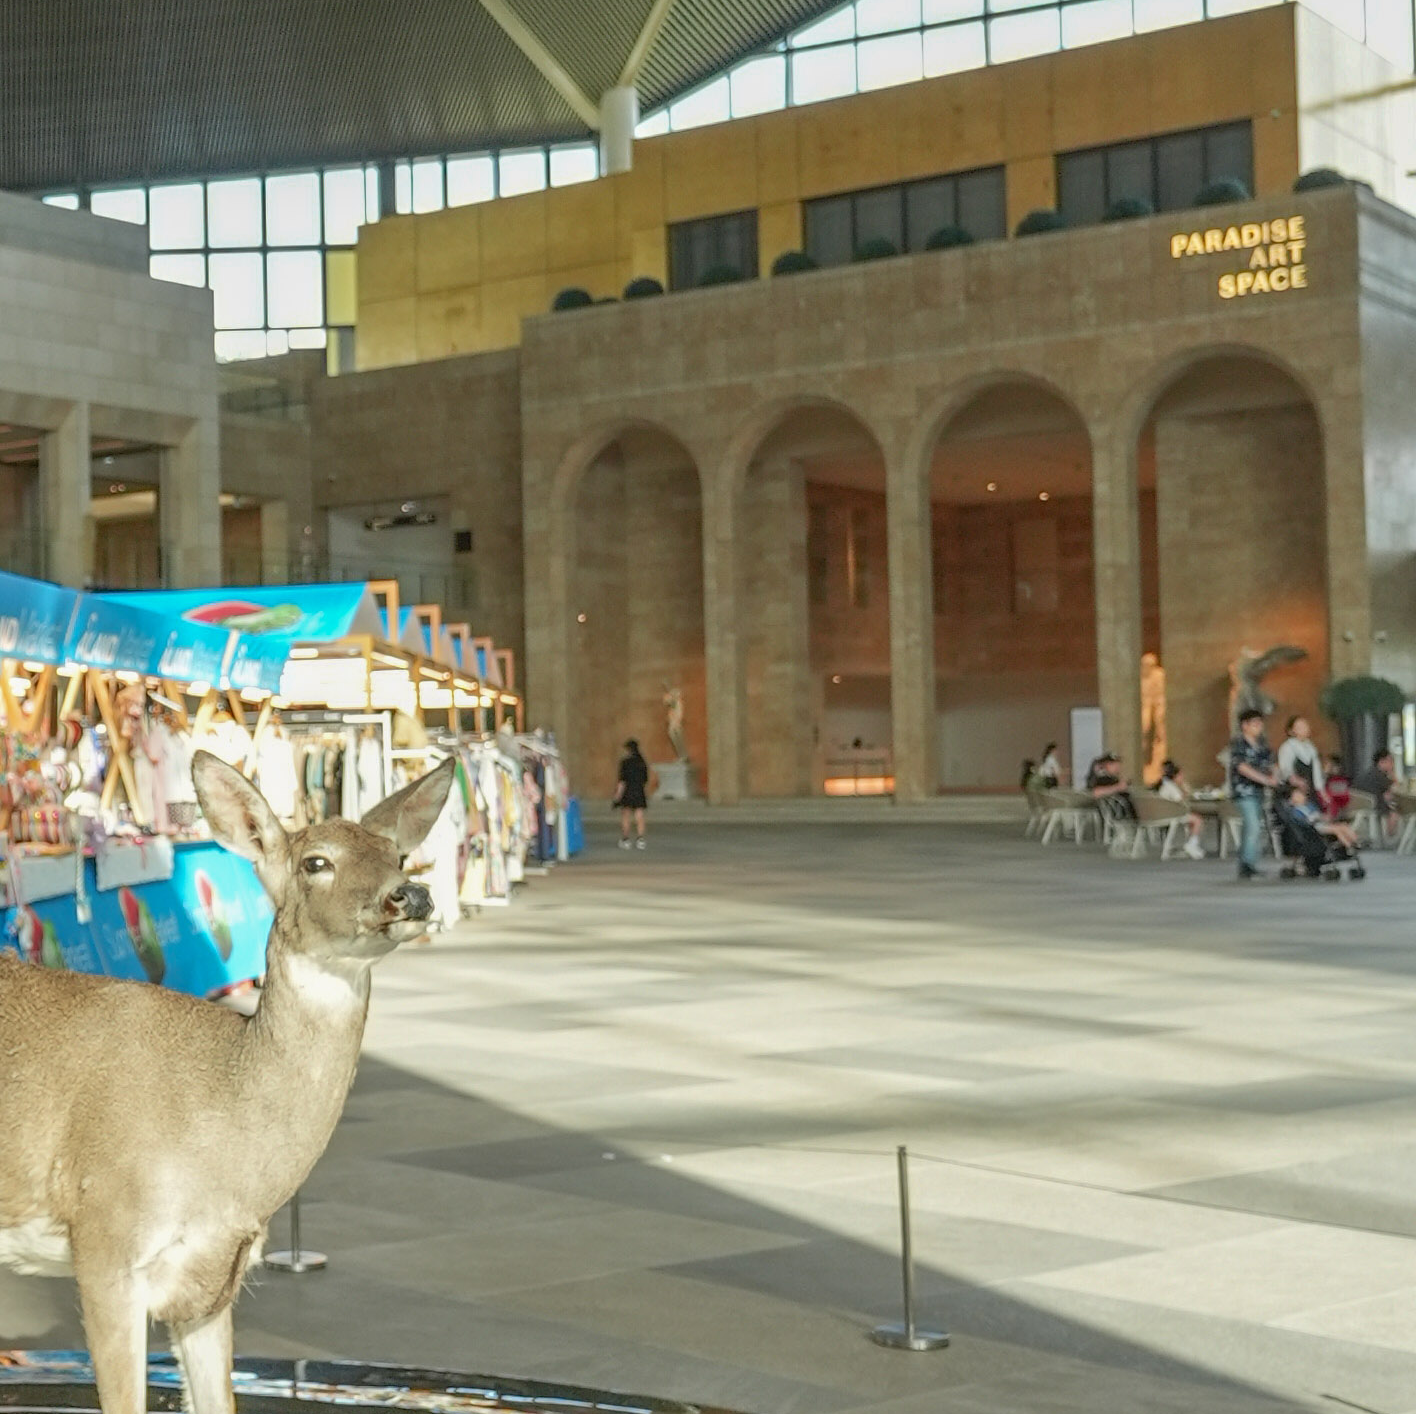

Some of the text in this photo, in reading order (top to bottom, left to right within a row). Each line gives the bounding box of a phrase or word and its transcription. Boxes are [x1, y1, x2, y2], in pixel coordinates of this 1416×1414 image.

[1170, 215, 1306, 259] PARADISE
[1249, 239, 1306, 269] ART
[1218, 264, 1308, 299] SPACE
